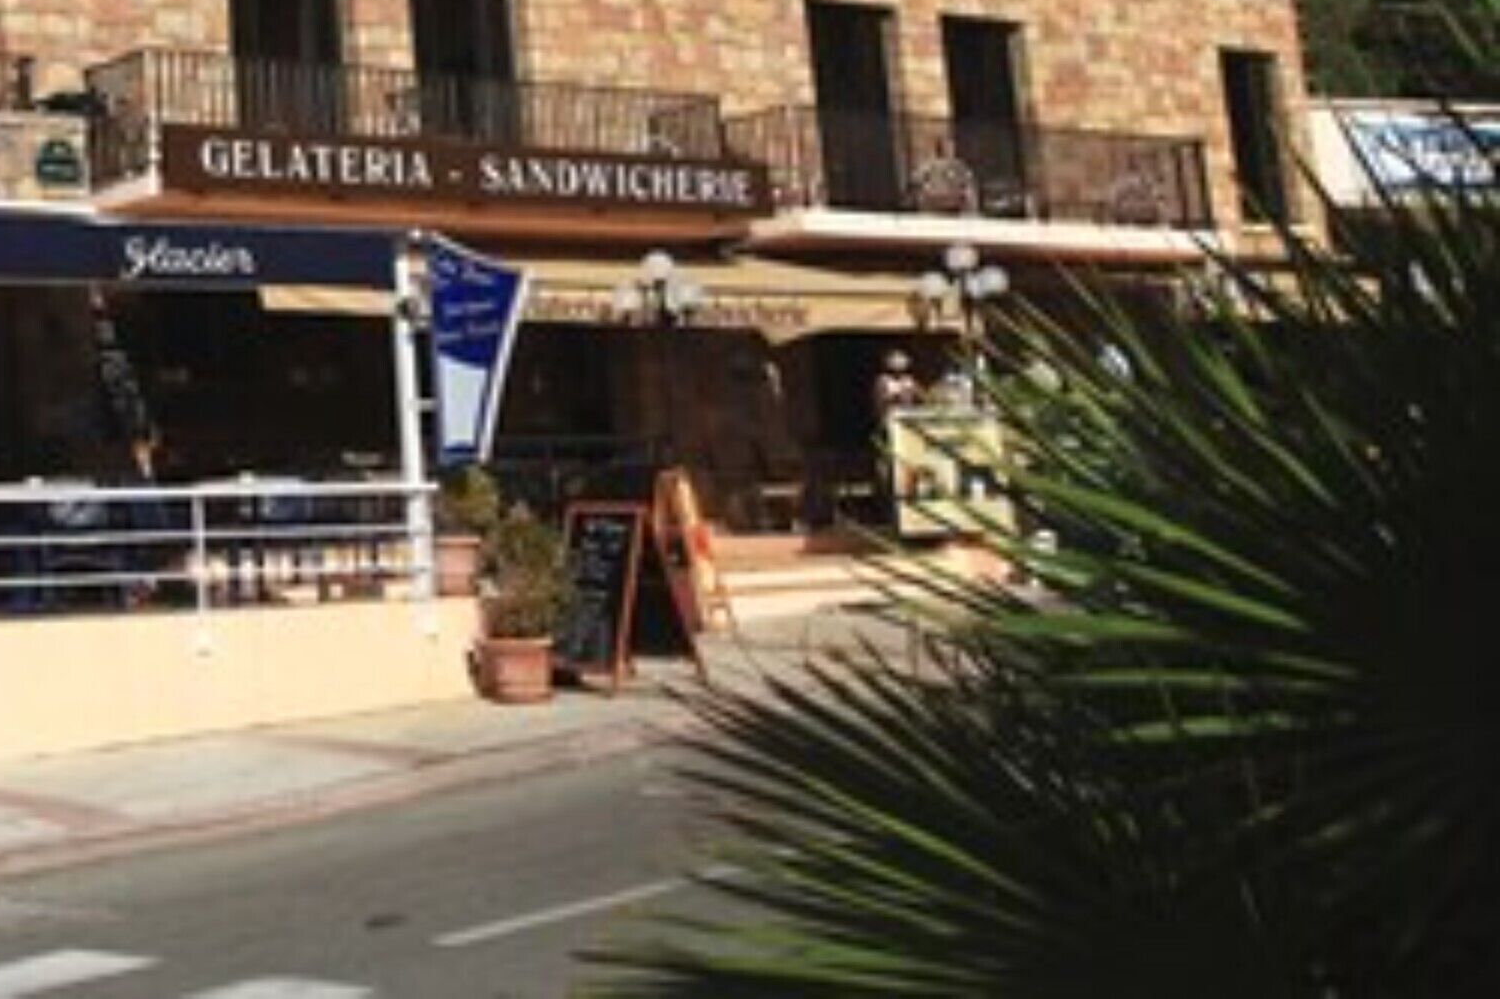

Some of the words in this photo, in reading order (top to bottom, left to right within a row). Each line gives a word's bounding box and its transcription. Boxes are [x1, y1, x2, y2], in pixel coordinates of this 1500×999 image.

[202, 136, 433, 187] GELATERIA
[479, 154, 754, 205] SANDWICHERIE
[119, 235, 256, 281] Glacier
